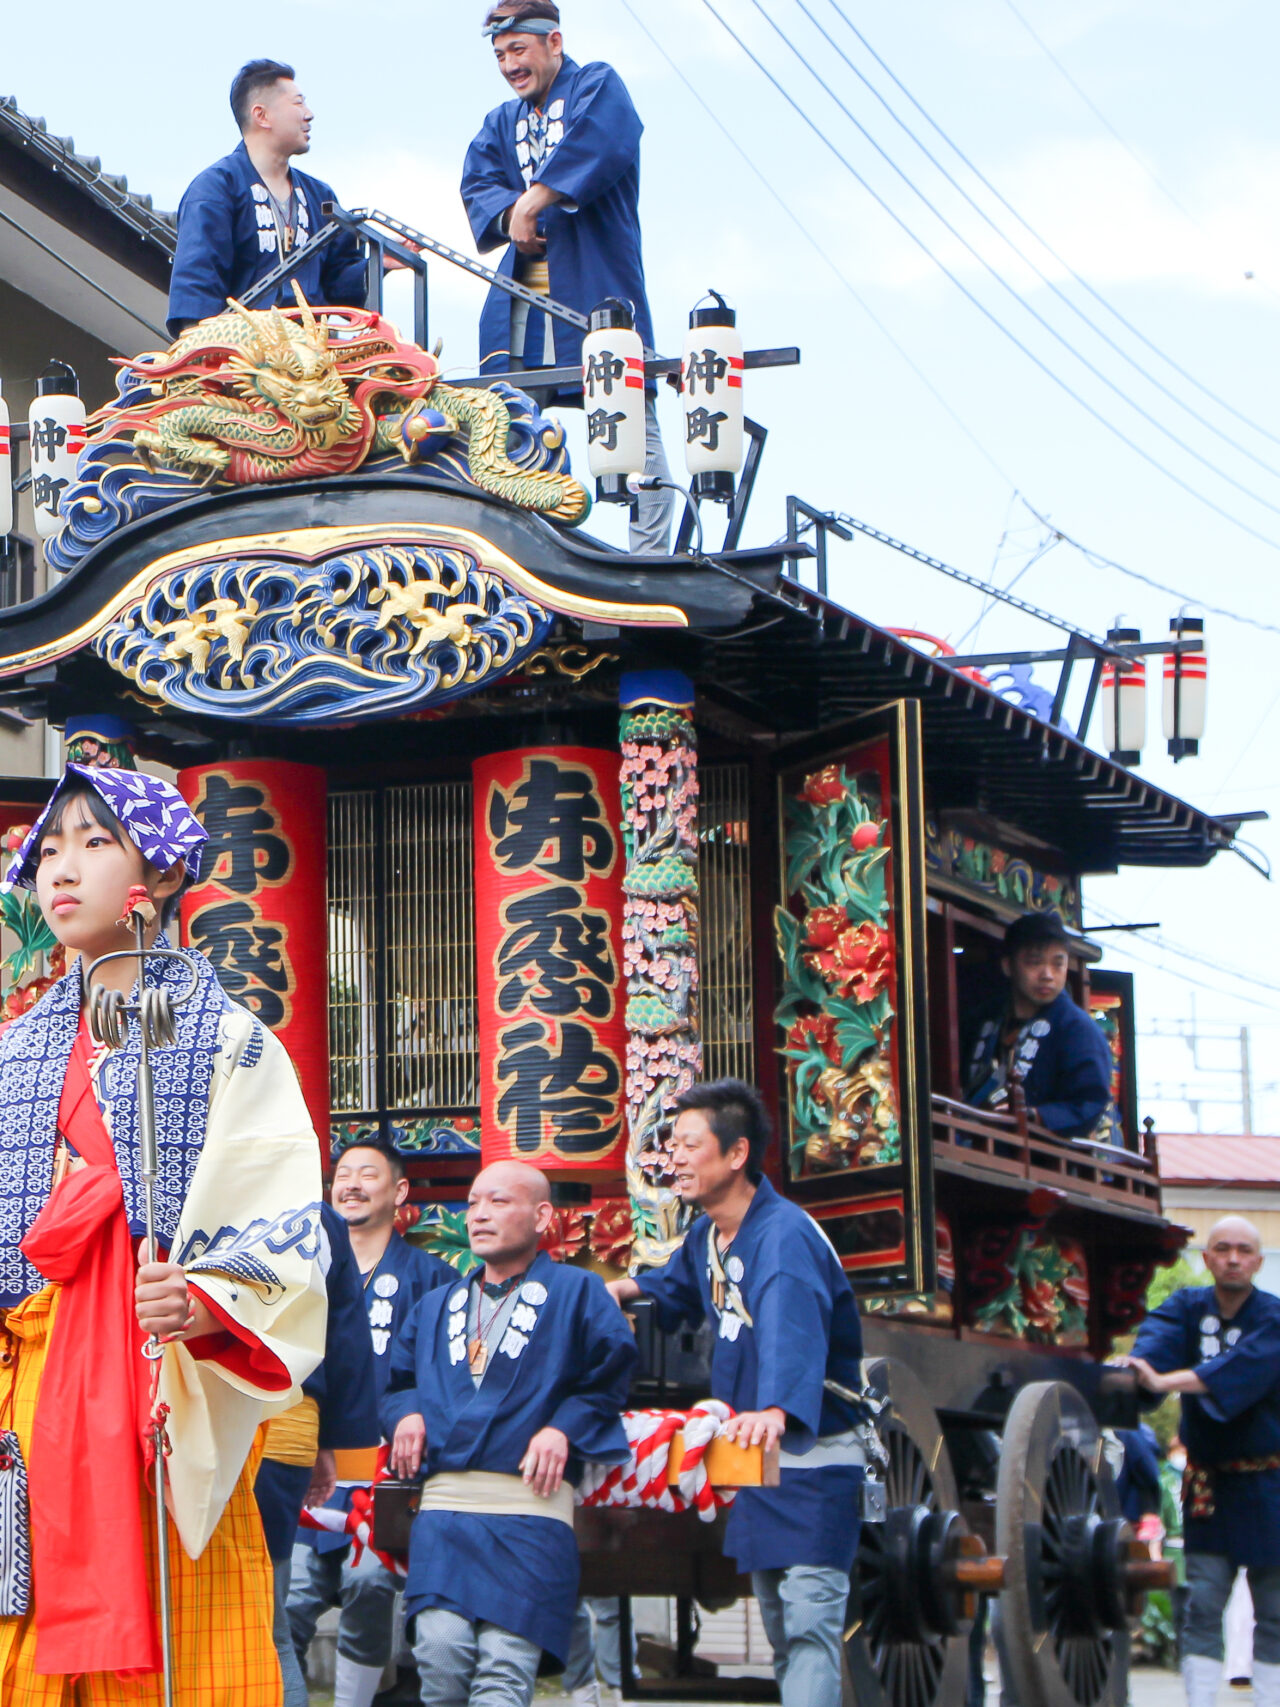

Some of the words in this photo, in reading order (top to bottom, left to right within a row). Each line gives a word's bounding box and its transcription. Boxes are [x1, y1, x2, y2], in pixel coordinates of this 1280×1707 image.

[586, 350, 627, 451] 仲町
[686, 348, 728, 451] 仲町
[32, 417, 69, 517] 仲町
